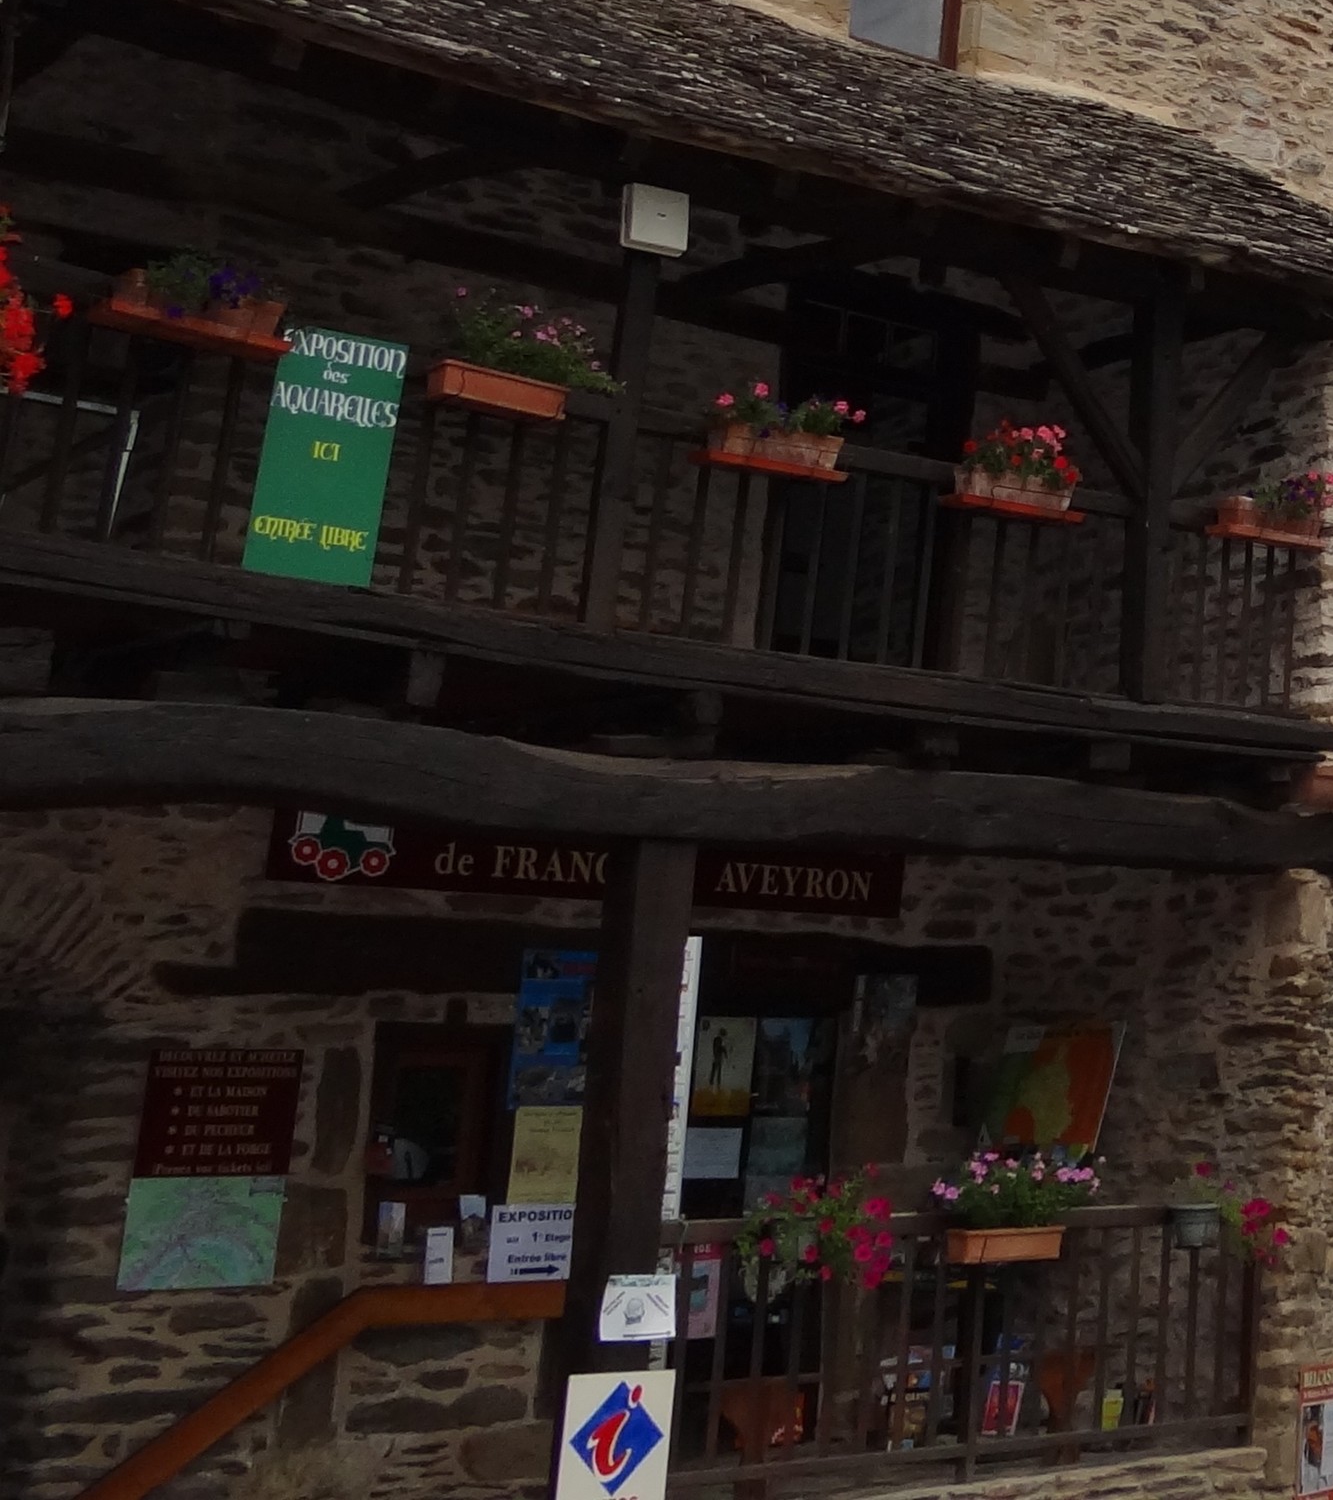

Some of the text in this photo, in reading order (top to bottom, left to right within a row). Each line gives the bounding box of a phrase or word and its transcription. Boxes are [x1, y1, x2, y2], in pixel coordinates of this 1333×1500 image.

[323, 361, 350, 384] des
[271, 381, 400, 428] AQUARELLES
[311, 441, 340, 461] ICI
[319, 525, 369, 551] LIBRE
[434, 840, 874, 901] de FRANC AVEYRON
[498, 1209, 572, 1223] EXPOSITIO
